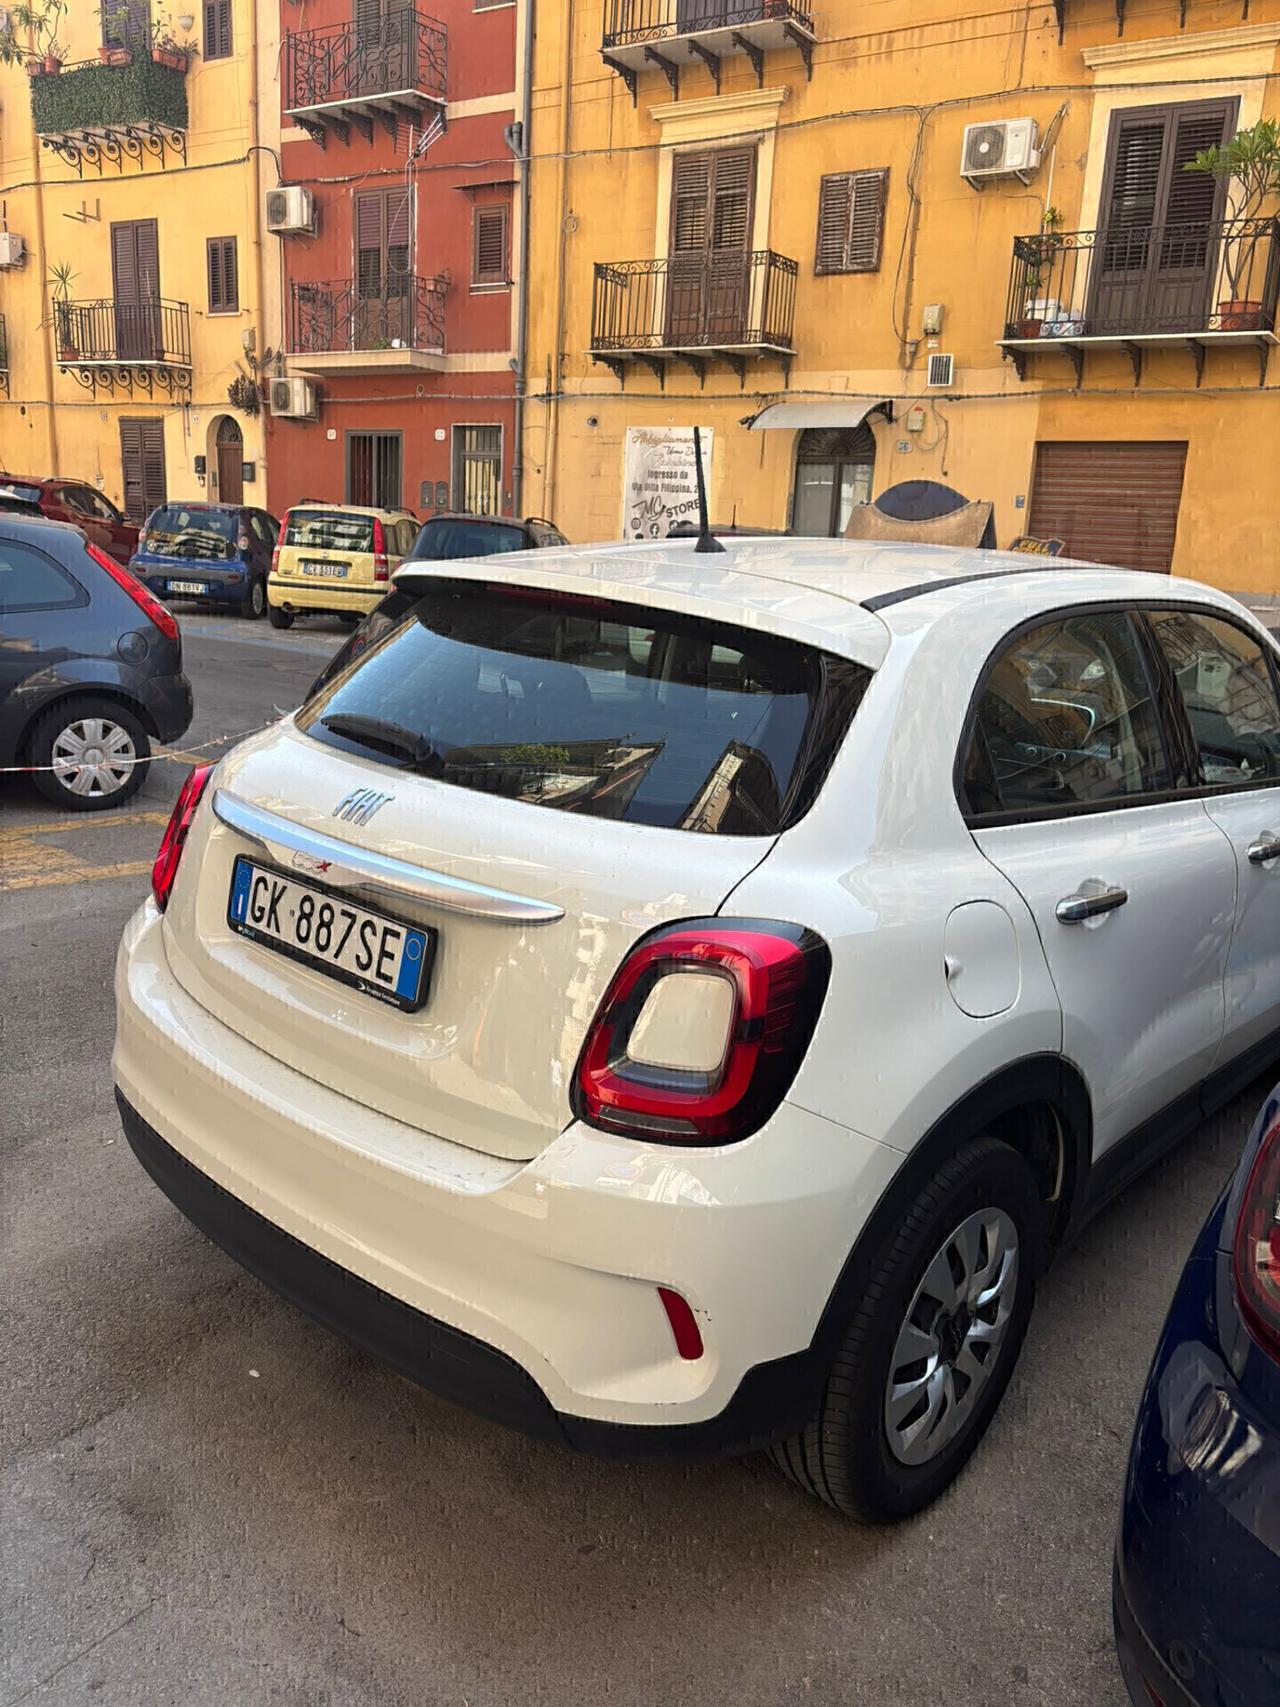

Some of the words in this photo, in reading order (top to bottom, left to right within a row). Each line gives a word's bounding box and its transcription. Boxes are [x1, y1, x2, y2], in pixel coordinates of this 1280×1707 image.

[647, 469, 678, 480] Ingresso
[679, 470, 689, 480] da
[631, 482, 643, 492] Via
[643, 482, 660, 493] Villa
[665, 498, 701, 518] STORE
[331, 786, 396, 827] FIAT
[251, 875, 288, 934] GK
[295, 894, 402, 985] 887SE
